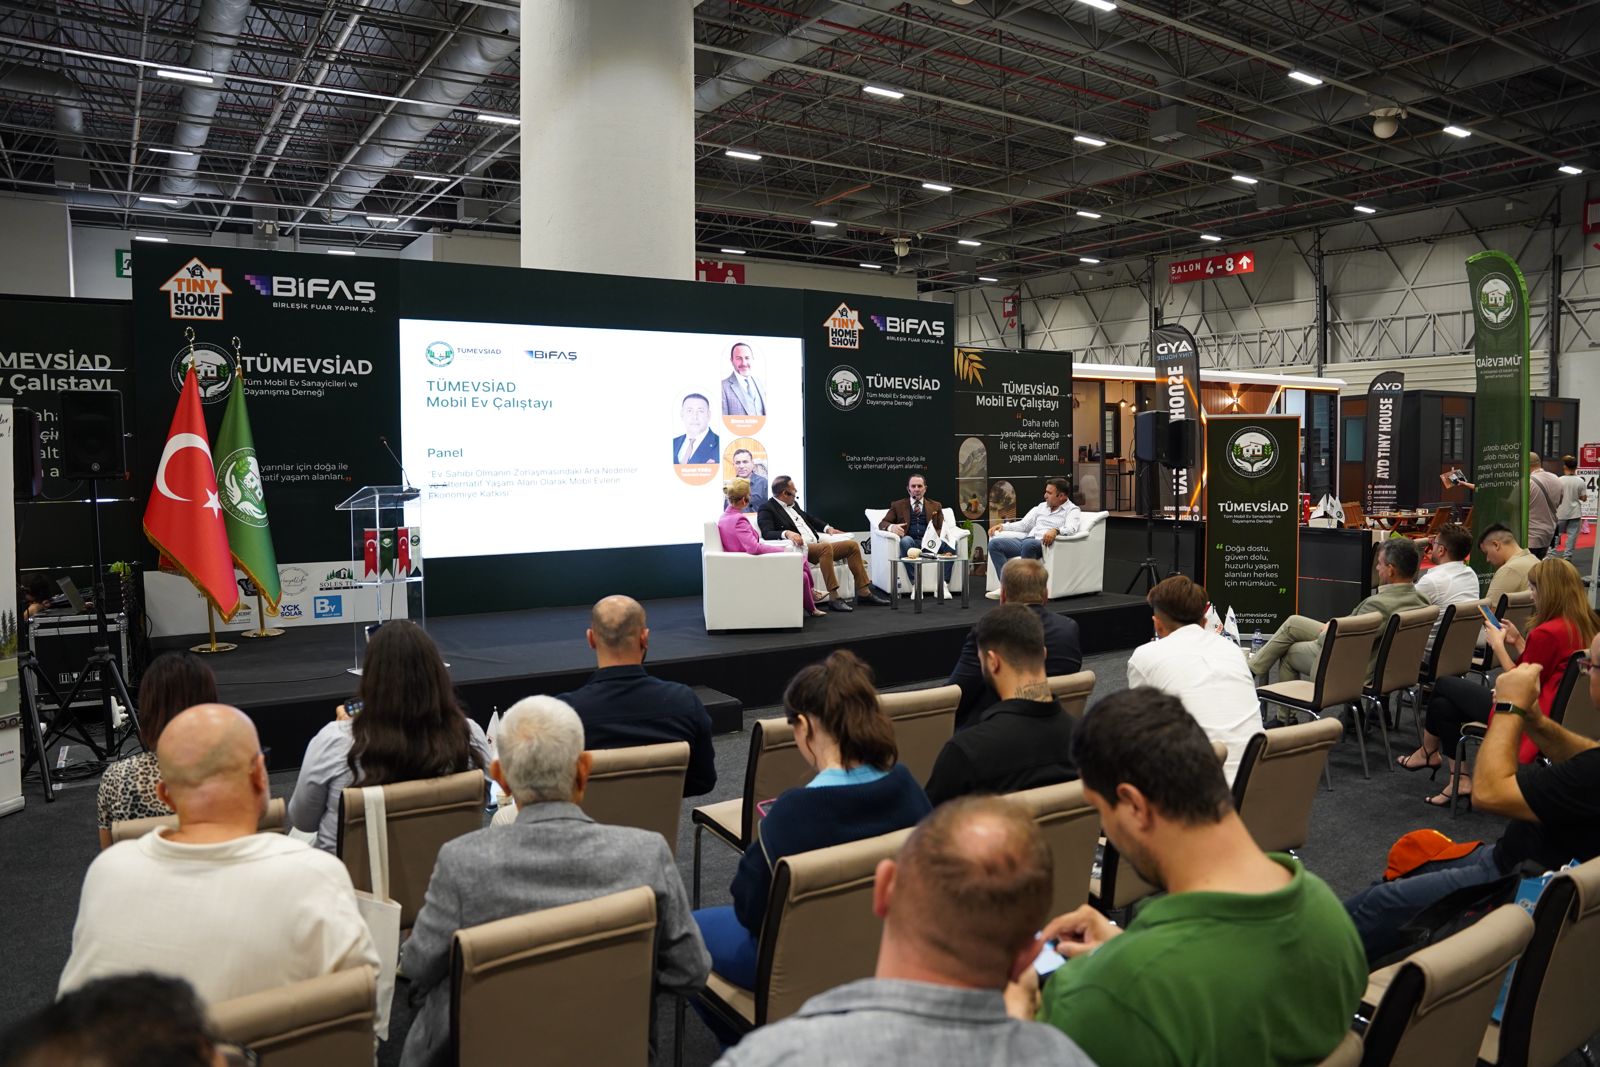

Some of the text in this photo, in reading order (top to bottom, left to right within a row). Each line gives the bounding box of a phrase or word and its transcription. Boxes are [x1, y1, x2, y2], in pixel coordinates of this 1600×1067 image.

[1171, 262, 1200, 274] SALON
[174, 278, 218, 293] TINY
[173, 292, 220, 306] HOME
[174, 304, 220, 317] SHOW
[272, 302, 308, 310] BİRLEŞİK
[831, 318, 856, 329] TINY
[831, 328, 857, 338] HOME
[831, 337, 857, 346] SHOW
[242, 352, 373, 375] TÜMEVSİAD
[302, 380, 346, 388] Sanayicileri
[426, 378, 516, 393] TÜMEVSİAD
[866, 373, 940, 391] TÜMEVSİAD
[1372, 382, 1402, 390] AYD
[244, 388, 325, 397] Dayanışma Derneği
[1002, 380, 1060, 396] TÜMEVSİAD
[426, 396, 553, 410] Mobil Ev Çalıştayı
[976, 396, 1059, 411] Mobil Ev Çalıştayı
[1378, 398, 1393, 432] HOUSE
[1022, 418, 1060, 428] Daha refah
[1042, 430, 1060, 440] doğa
[1000, 441, 1060, 451] ile iç içe alternatif
[1378, 434, 1392, 458] TINY
[427, 448, 464, 458] Panel
[1009, 454, 1032, 463] yaşam
[296, 463, 312, 472] için
[314, 463, 336, 472] doğa
[338, 462, 349, 470] ile
[1376, 460, 1390, 479] AYD
[280, 474, 310, 482] yaşam
[1218, 500, 1288, 512] TÜMEVSİAD
[1225, 544, 1246, 553] Doğa
